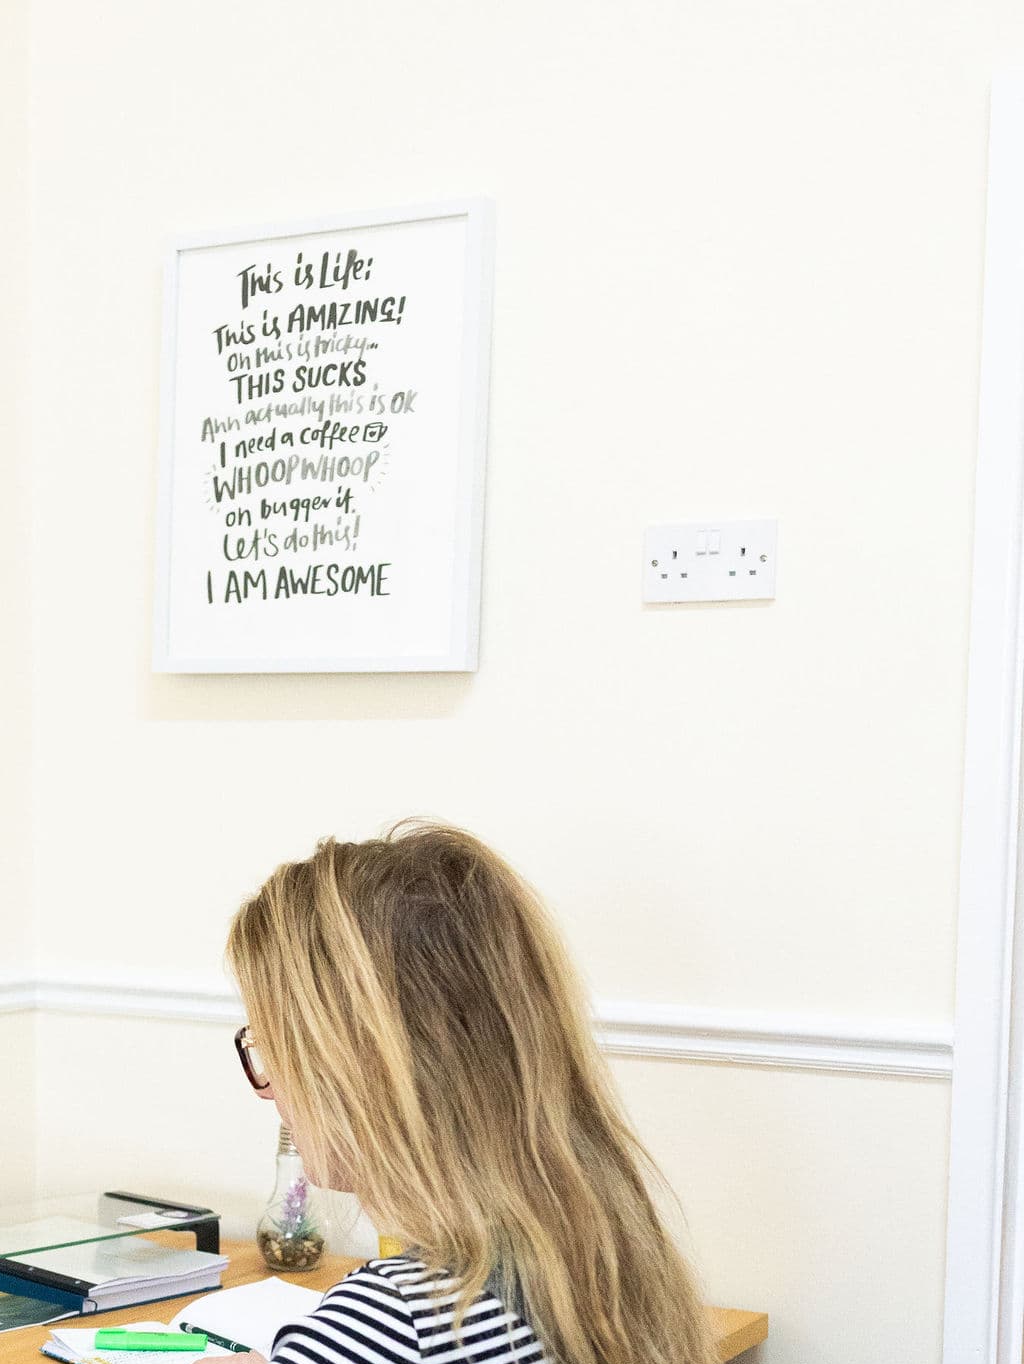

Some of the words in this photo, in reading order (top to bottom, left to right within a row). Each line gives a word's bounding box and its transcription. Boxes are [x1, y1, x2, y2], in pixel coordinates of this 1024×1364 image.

[237, 263, 284, 309] This
[294, 252, 314, 290] is
[319, 249, 373, 290] Life:
[212, 320, 256, 355] This
[262, 310, 281, 340] is
[287, 296, 406, 334] AMAZING!
[227, 352, 251, 372] Oh
[255, 340, 293, 368] this
[297, 334, 311, 362] is
[229, 368, 285, 404] THIS
[292, 359, 367, 393] SUCKS
[244, 395, 325, 425] actually
[328, 389, 364, 416] this
[368, 382, 386, 415] is
[390, 389, 418, 414] OK
[220, 441, 226, 468] I
[235, 427, 276, 458] need
[281, 431, 294, 446] a
[300, 420, 359, 449] coffee
[261, 496, 332, 522] bugger
[284, 527, 309, 553] do
[313, 515, 361, 551] this!
[207, 570, 213, 604] I
[225, 569, 267, 604] AM
[274, 563, 392, 599] AWESOME
